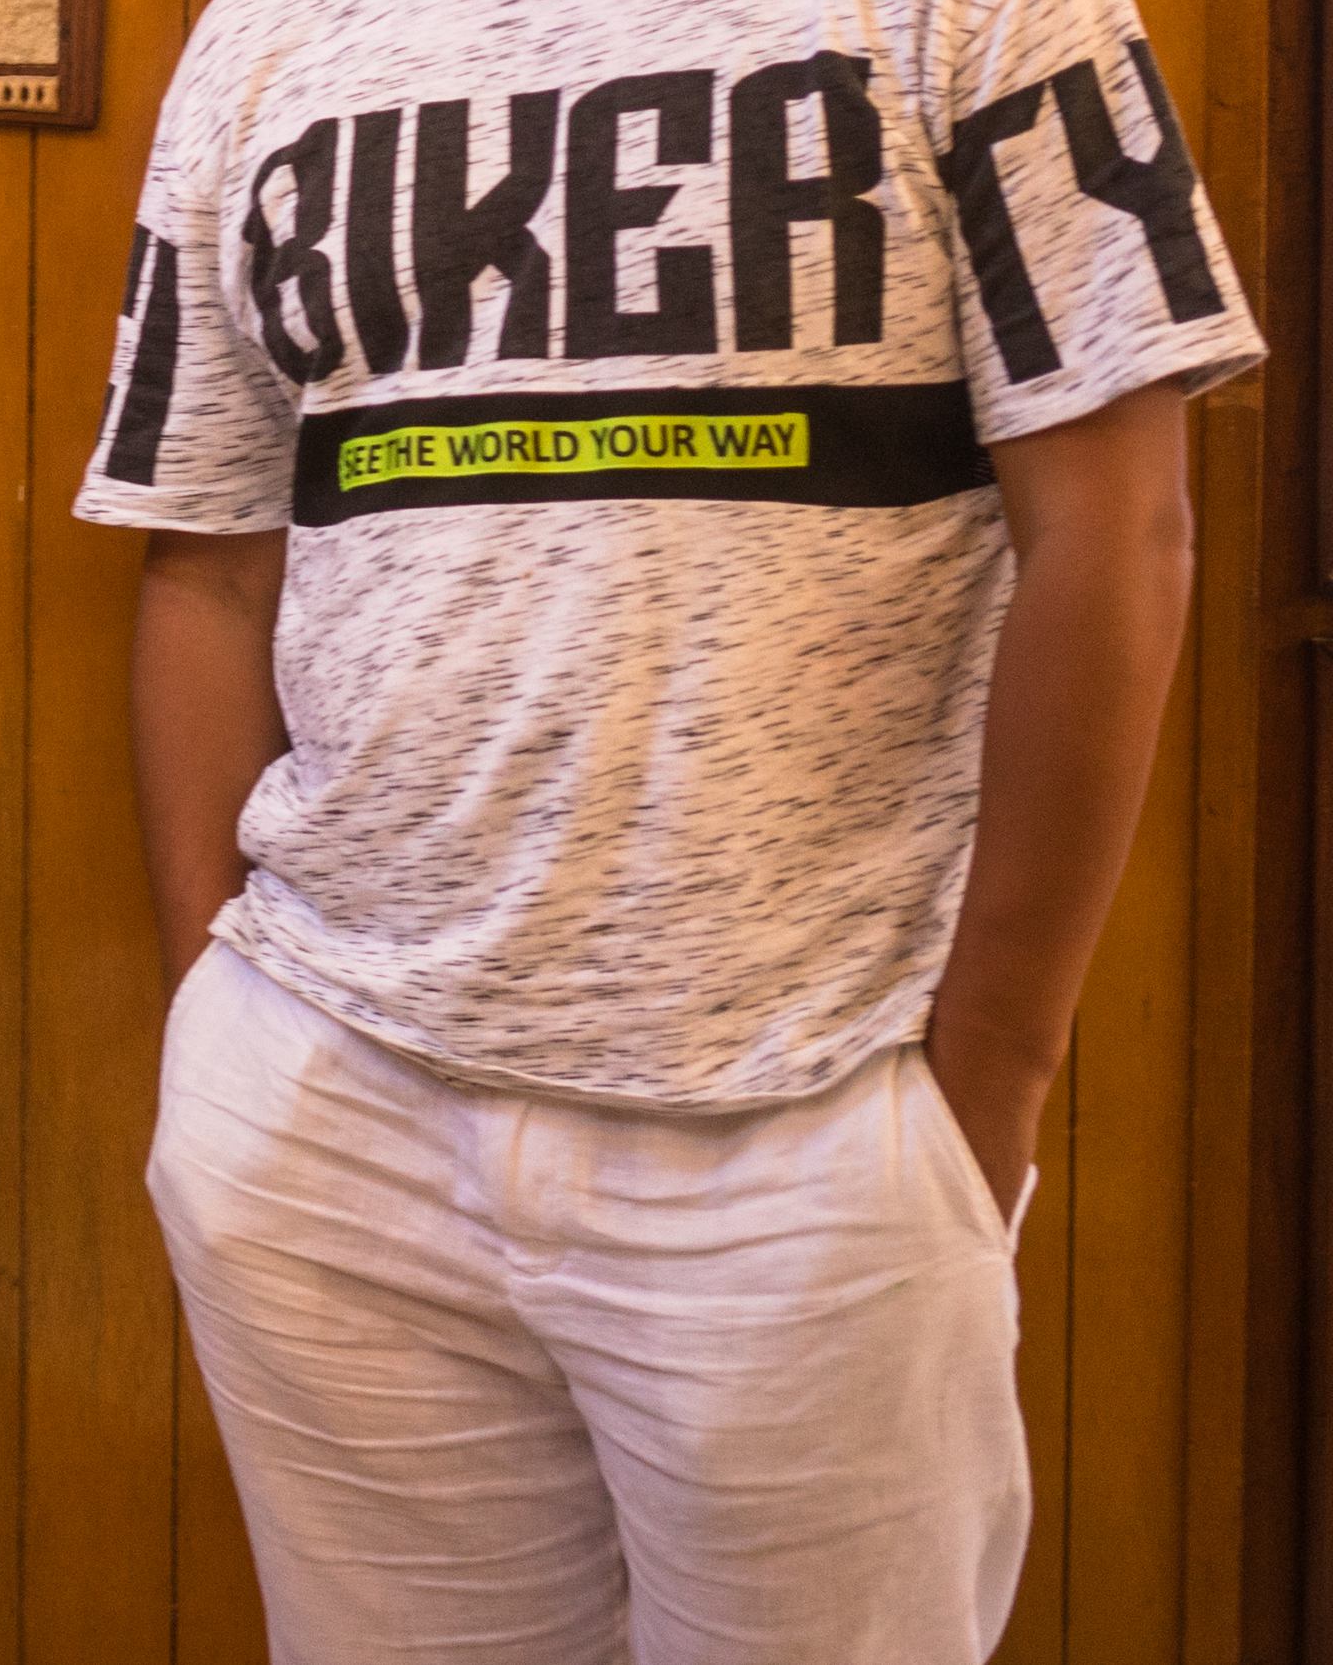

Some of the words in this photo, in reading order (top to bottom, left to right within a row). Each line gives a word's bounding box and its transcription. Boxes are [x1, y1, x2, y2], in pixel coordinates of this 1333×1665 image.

[241, 49, 885, 385] BIKER
[937, 38, 1228, 384] TY
[343, 444, 380, 481] SEE
[384, 434, 435, 470] THE
[447, 429, 581, 466] WORLD
[589, 423, 697, 460] YOUR
[707, 421, 797, 458] WAY
